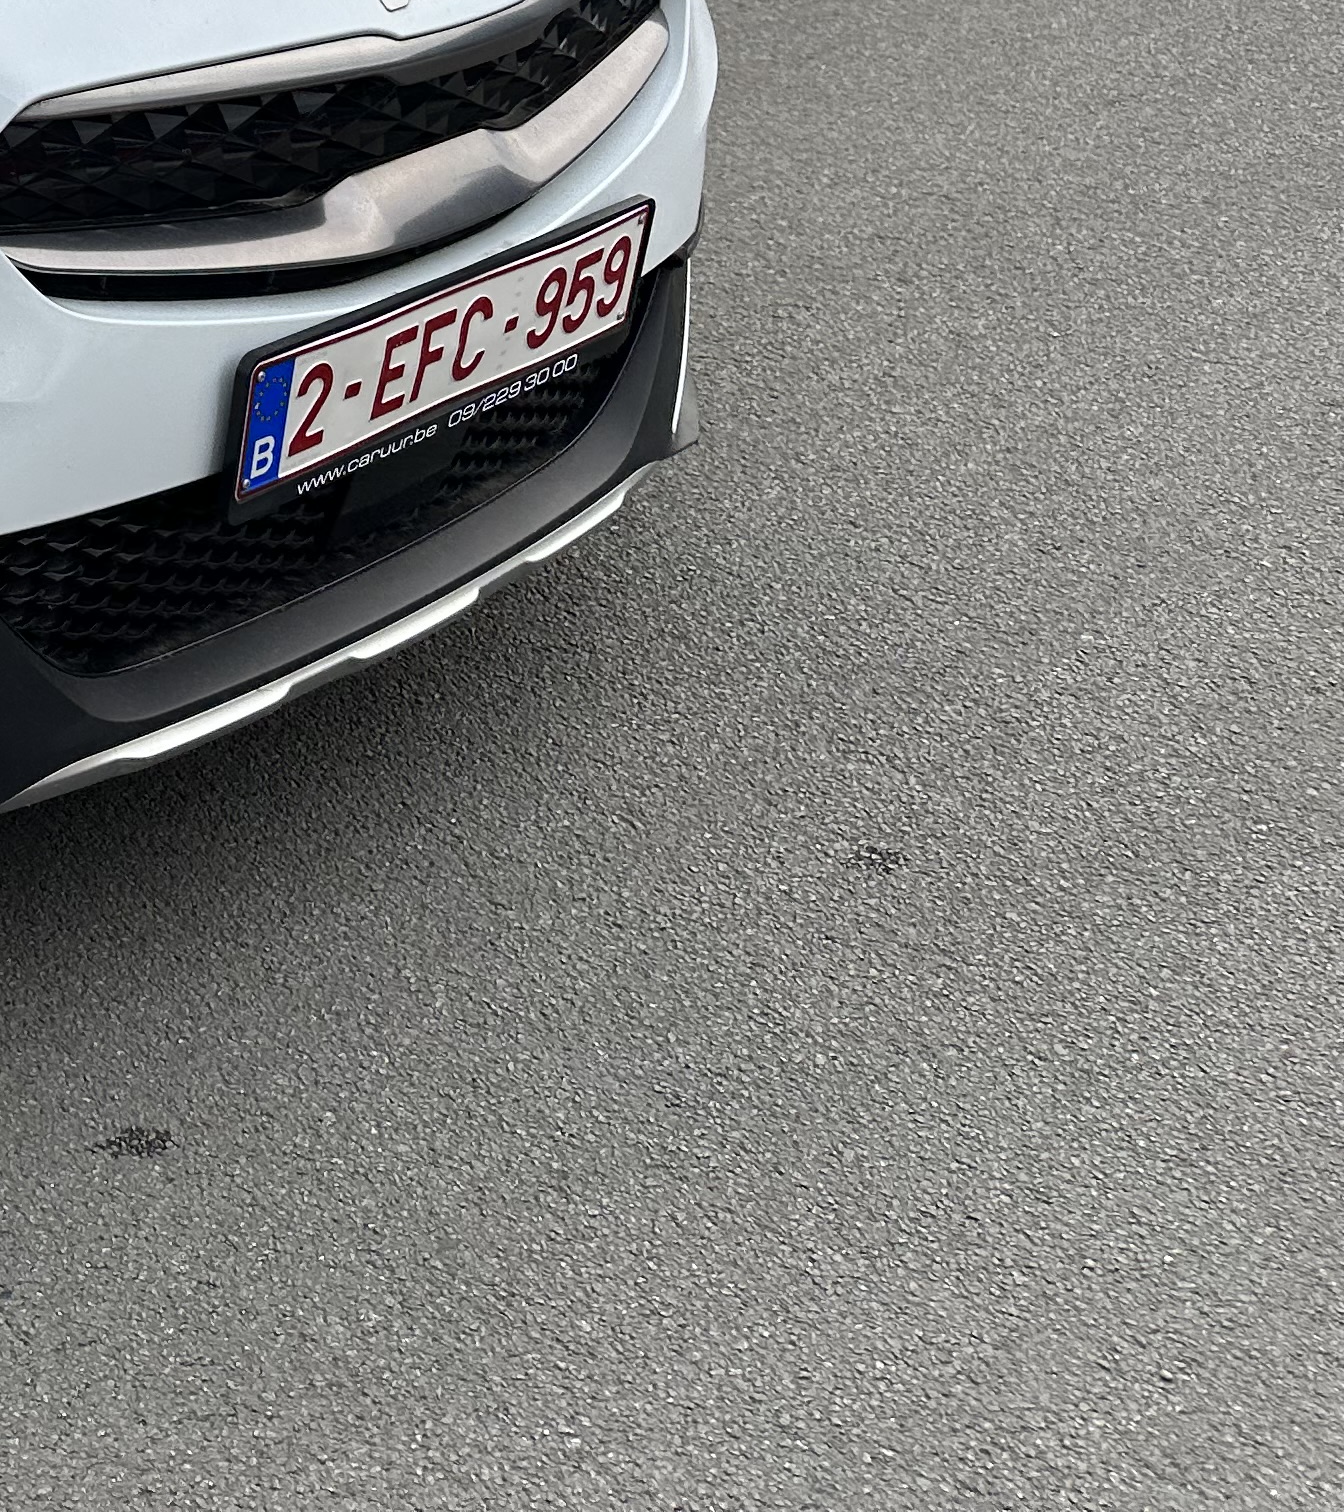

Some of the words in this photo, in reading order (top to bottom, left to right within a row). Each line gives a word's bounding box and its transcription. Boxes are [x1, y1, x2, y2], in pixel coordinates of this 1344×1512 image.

[249, 435, 277, 480] B
[287, 234, 633, 458] 2-EFC-959
[447, 385, 523, 428] 09/229
[552, 353, 579, 377] 00
